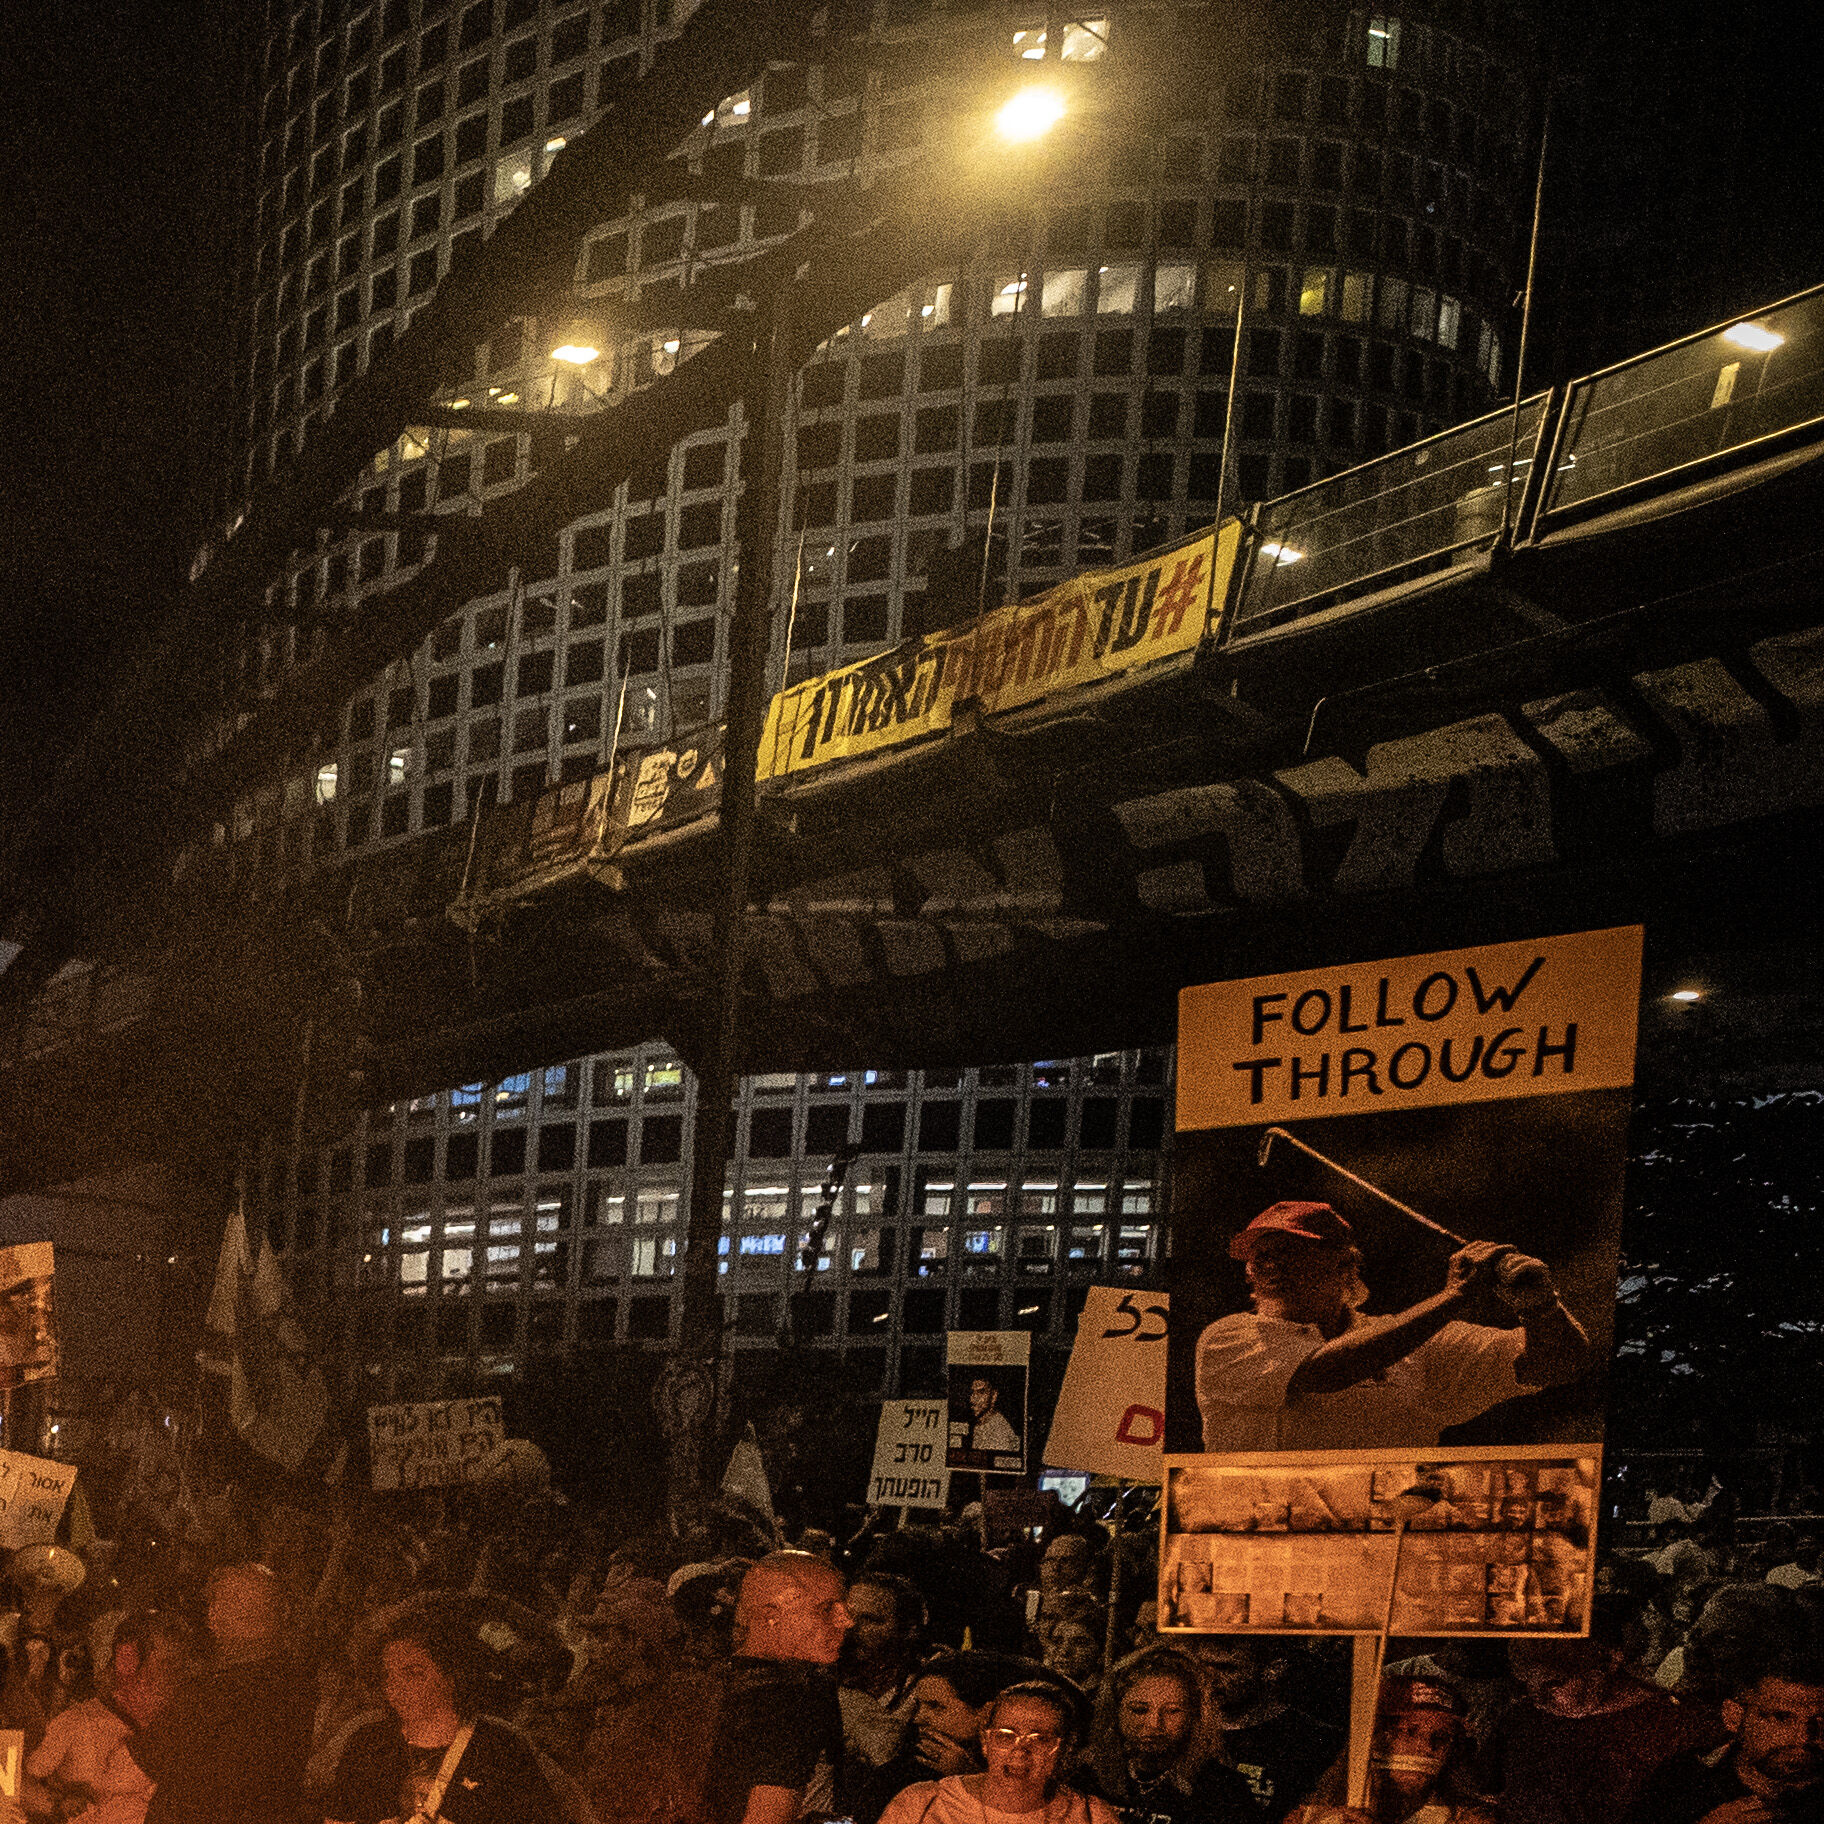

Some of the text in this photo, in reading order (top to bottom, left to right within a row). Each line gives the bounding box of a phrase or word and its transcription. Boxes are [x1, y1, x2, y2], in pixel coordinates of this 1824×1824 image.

[1251, 957, 1544, 1045] FOLLOW
[1233, 1023, 1579, 1105] THROUGH
[903, 1404, 940, 1429] חייל
[894, 1442, 933, 1463] סרב
[874, 1477, 942, 1500] הופעתך
